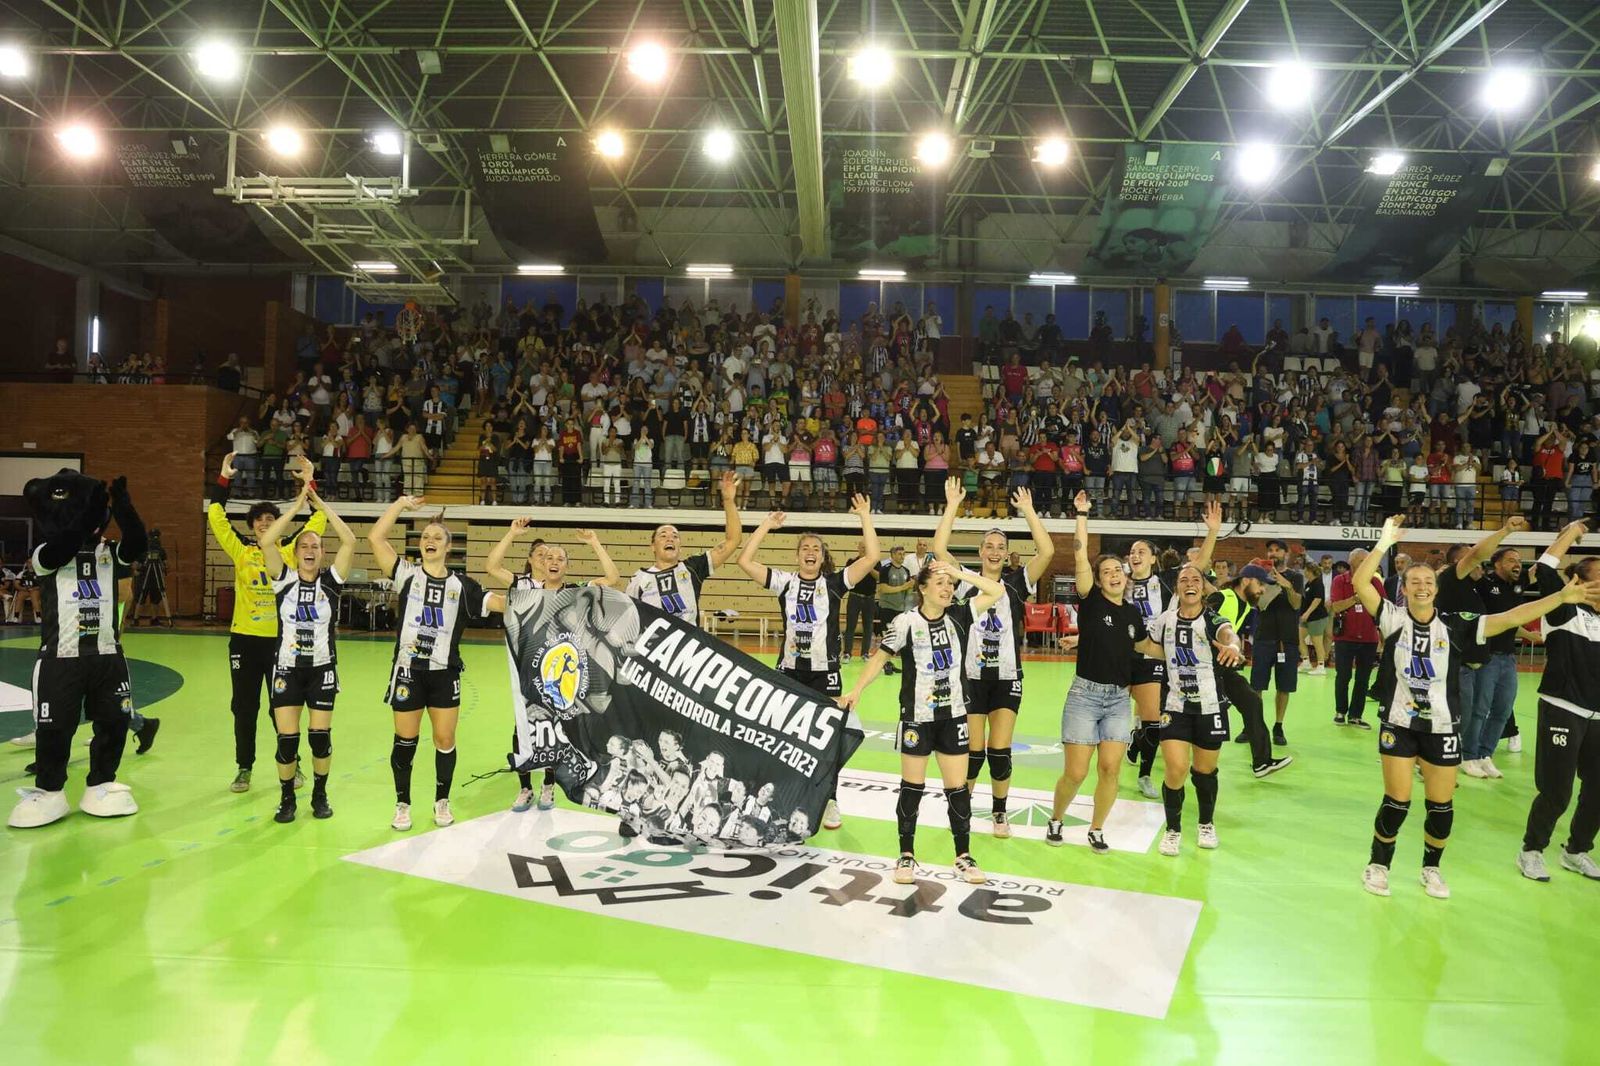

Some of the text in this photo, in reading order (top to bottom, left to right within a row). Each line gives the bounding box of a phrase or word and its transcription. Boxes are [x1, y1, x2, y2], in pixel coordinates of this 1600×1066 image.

[488, 160, 514, 168] OROS
[864, 165, 921, 174] CHAMPIONS
[1124, 172, 1160, 180] JUEGOS
[1420, 189, 1457, 197] JUEGOS
[1342, 528, 1382, 540] SALID
[82, 562, 91, 576] 8
[660, 576, 672, 592] 17
[300, 592, 314, 602] 18
[428, 588, 442, 604] 13
[800, 590, 814, 602] 57
[1134, 586, 1146, 598] 23
[931, 630, 948, 646] 20
[1179, 630, 1188, 644] 6
[1414, 636, 1428, 653] 27
[323, 670, 334, 684] 18
[634, 617, 844, 750] CAMPEONAS
[827, 672, 838, 685] 57
[40, 702, 50, 718] 8
[620, 656, 819, 778] LIGA IBERDROLA 2022/2023
[1214, 714, 1222, 729] 6
[956, 723, 969, 740] 20
[1442, 736, 1458, 753] 27
[1552, 734, 1568, 747] 68
